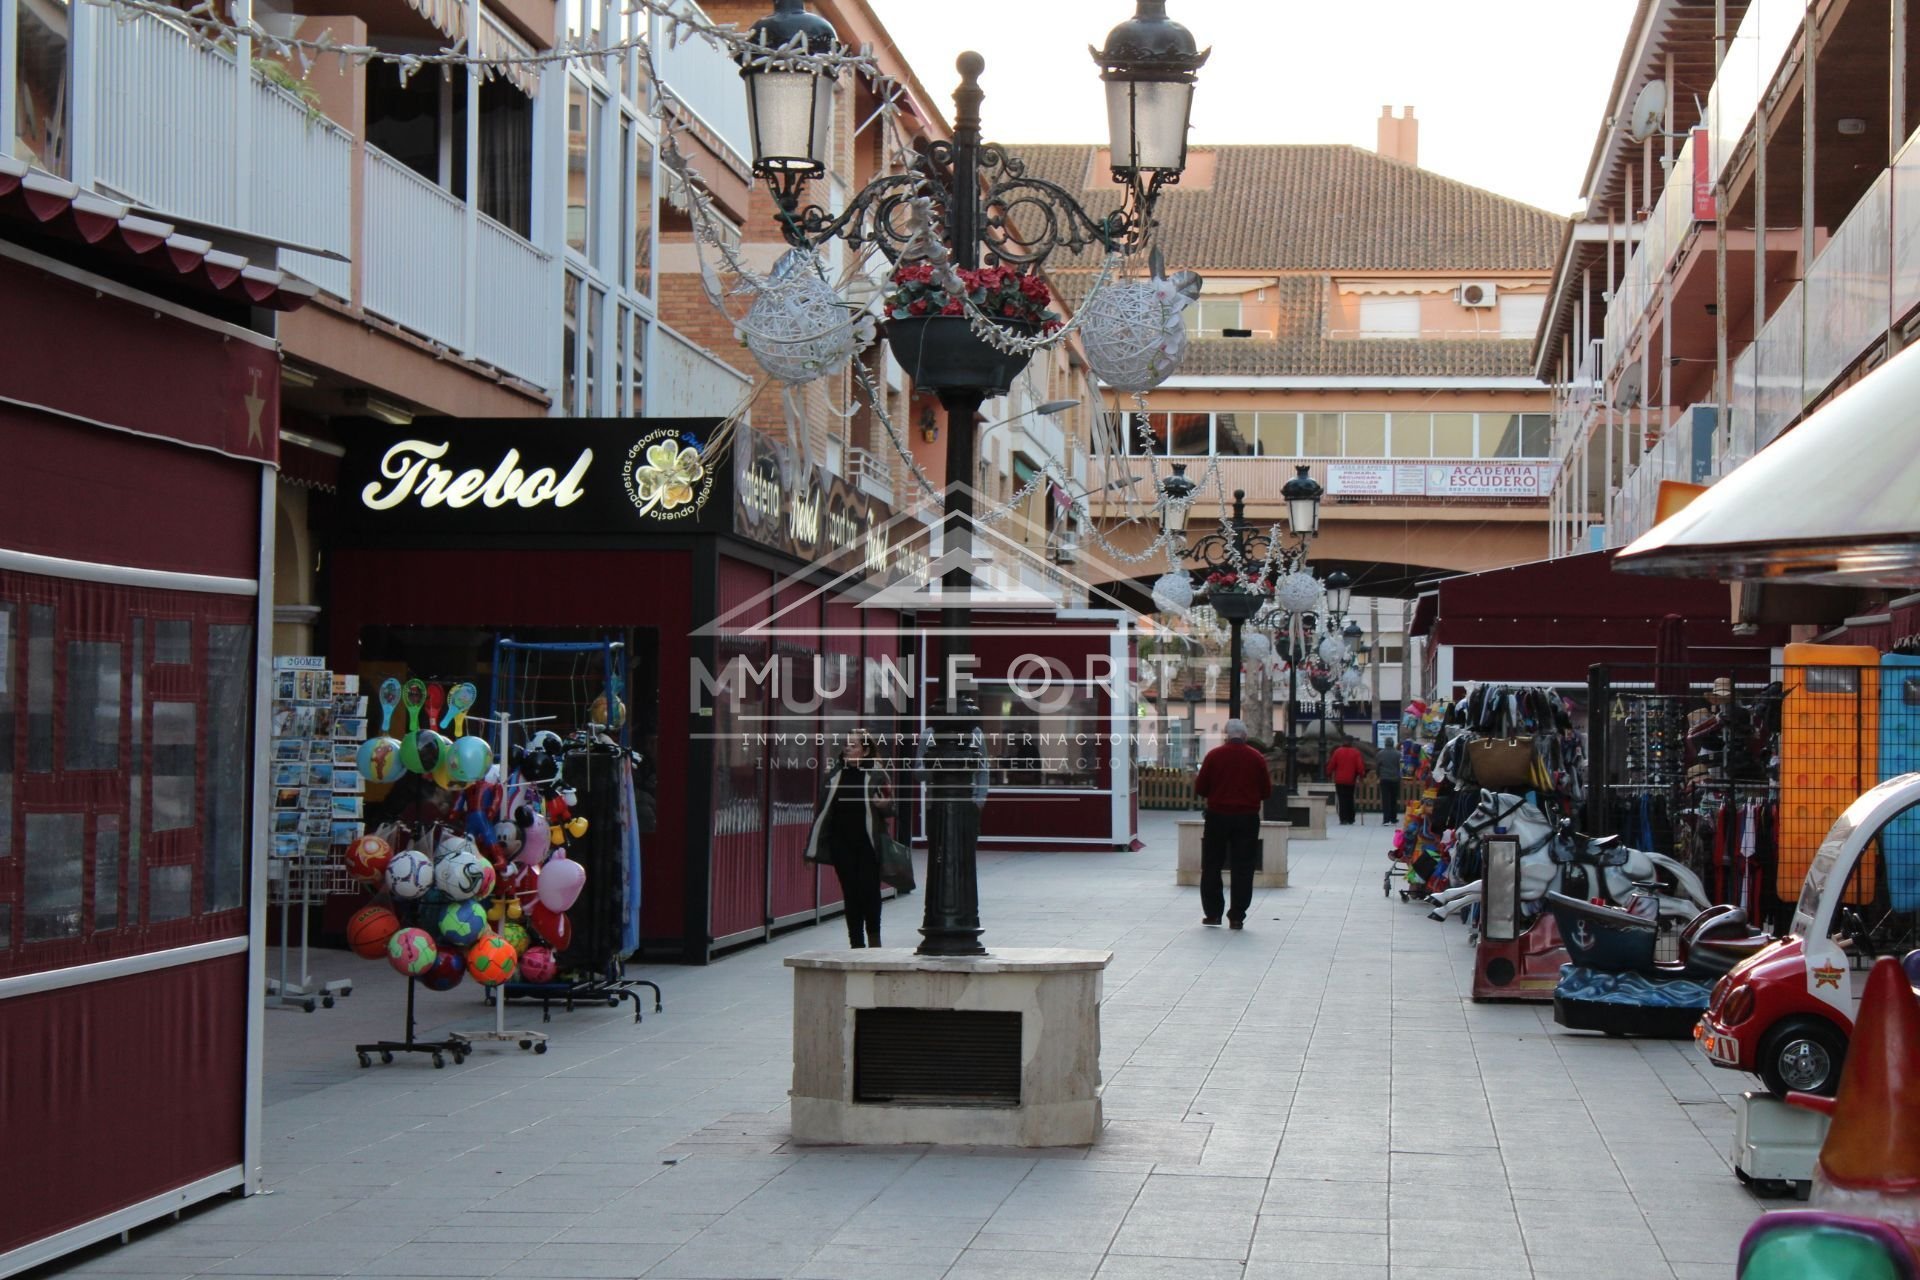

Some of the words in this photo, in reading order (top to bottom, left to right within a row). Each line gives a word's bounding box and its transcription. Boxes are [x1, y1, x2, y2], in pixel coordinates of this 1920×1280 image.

[628, 428, 681, 459] deportivas
[362, 439, 594, 510] Trebol
[1449, 475, 1536, 487] ESCUDERO
[1453, 466, 1532, 475] ACADEMIA
[621, 459, 643, 509] apuestas
[650, 505, 695, 521] apuesta
